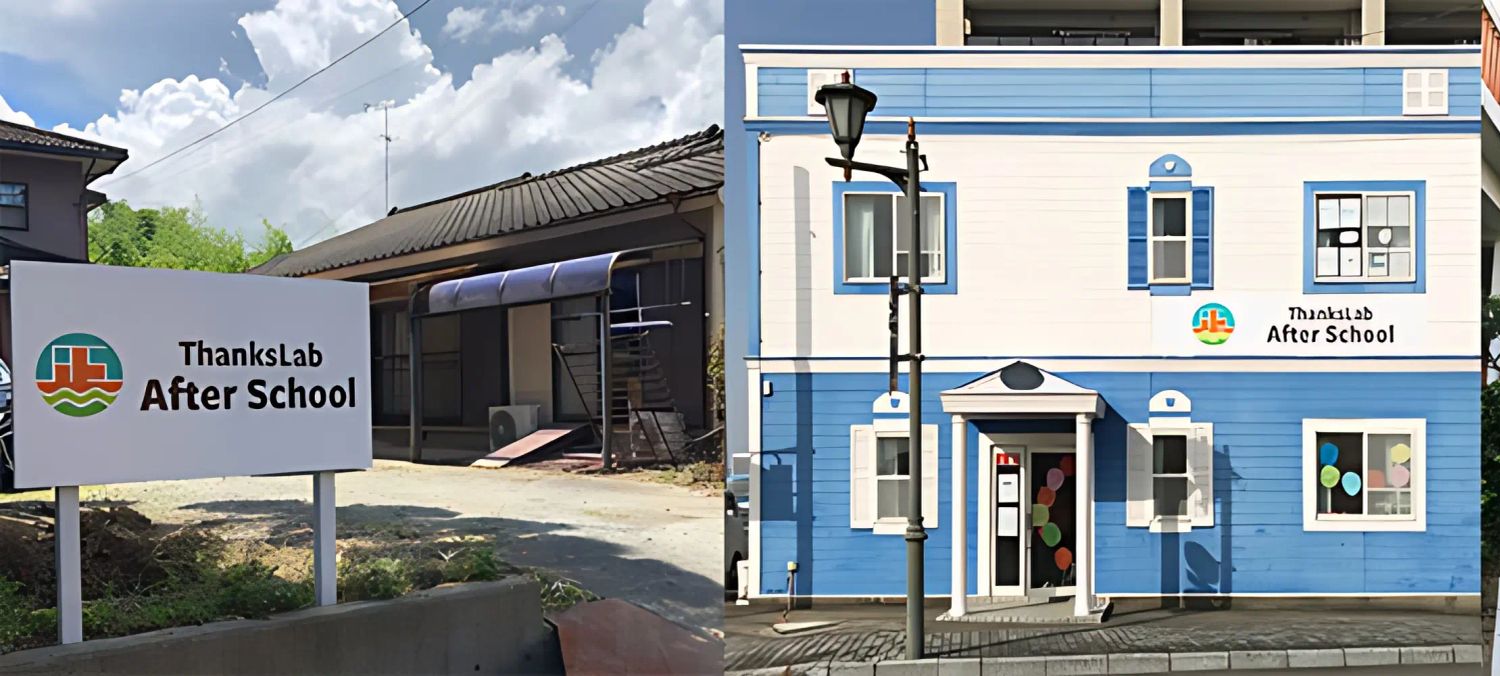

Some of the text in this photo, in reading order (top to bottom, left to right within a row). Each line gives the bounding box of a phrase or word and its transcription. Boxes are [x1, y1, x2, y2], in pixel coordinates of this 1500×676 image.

[1267, 323, 1395, 344] After School
[178, 339, 323, 368] ThanksLab
[140, 375, 356, 412] After School
